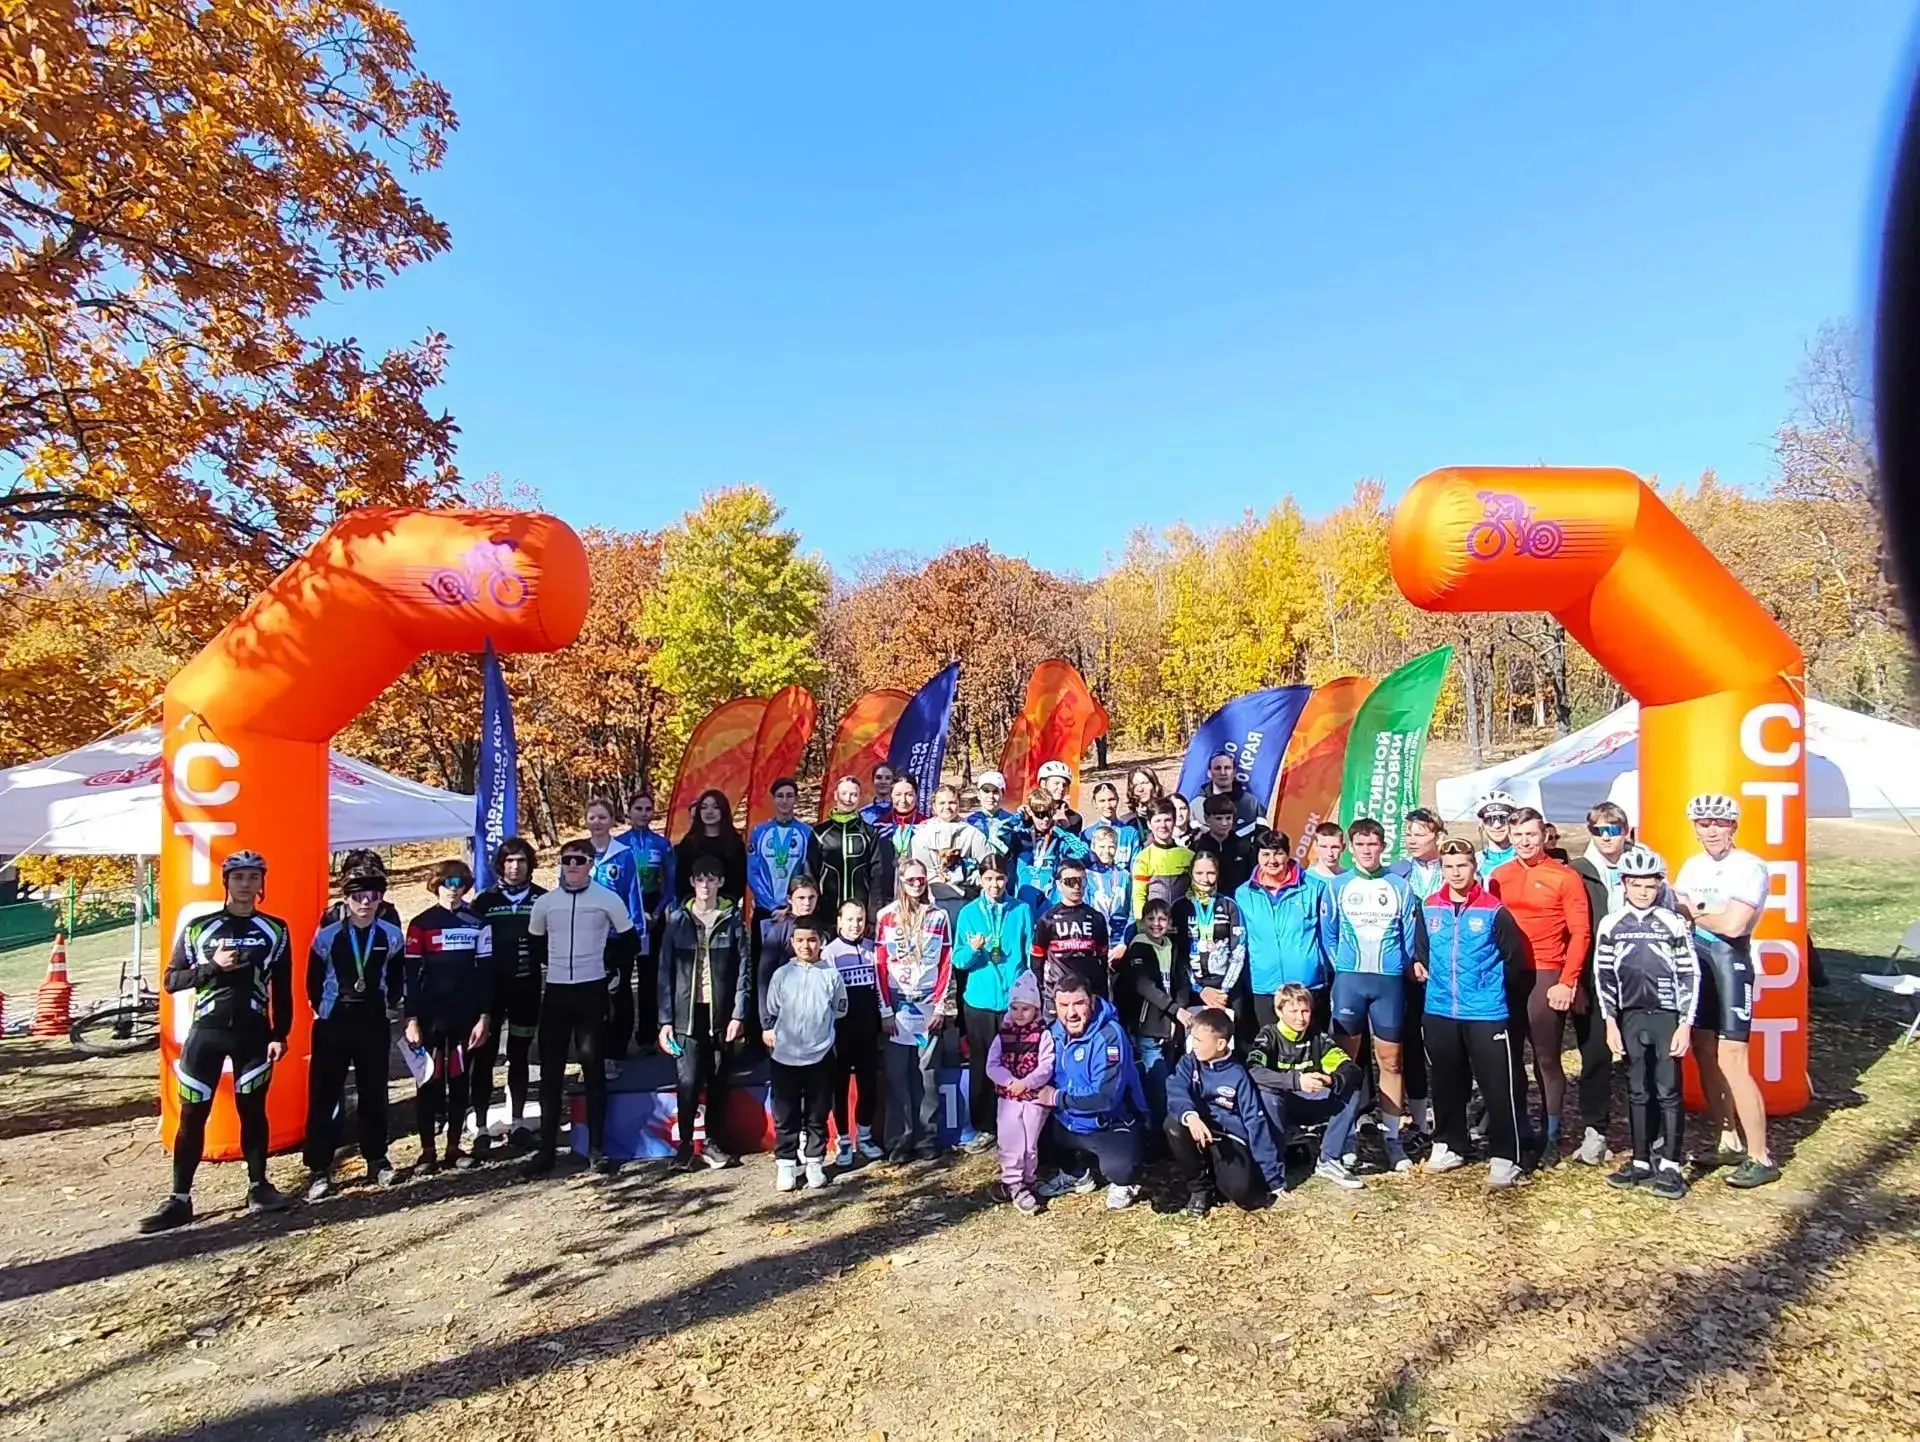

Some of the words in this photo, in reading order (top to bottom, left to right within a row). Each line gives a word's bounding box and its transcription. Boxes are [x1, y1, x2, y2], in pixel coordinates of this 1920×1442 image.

[1239, 731, 1264, 771] КРАЯ
[209, 937, 267, 948] MERIDA
[1055, 921, 1093, 937] UAE
[938, 1084, 958, 1129] 1
